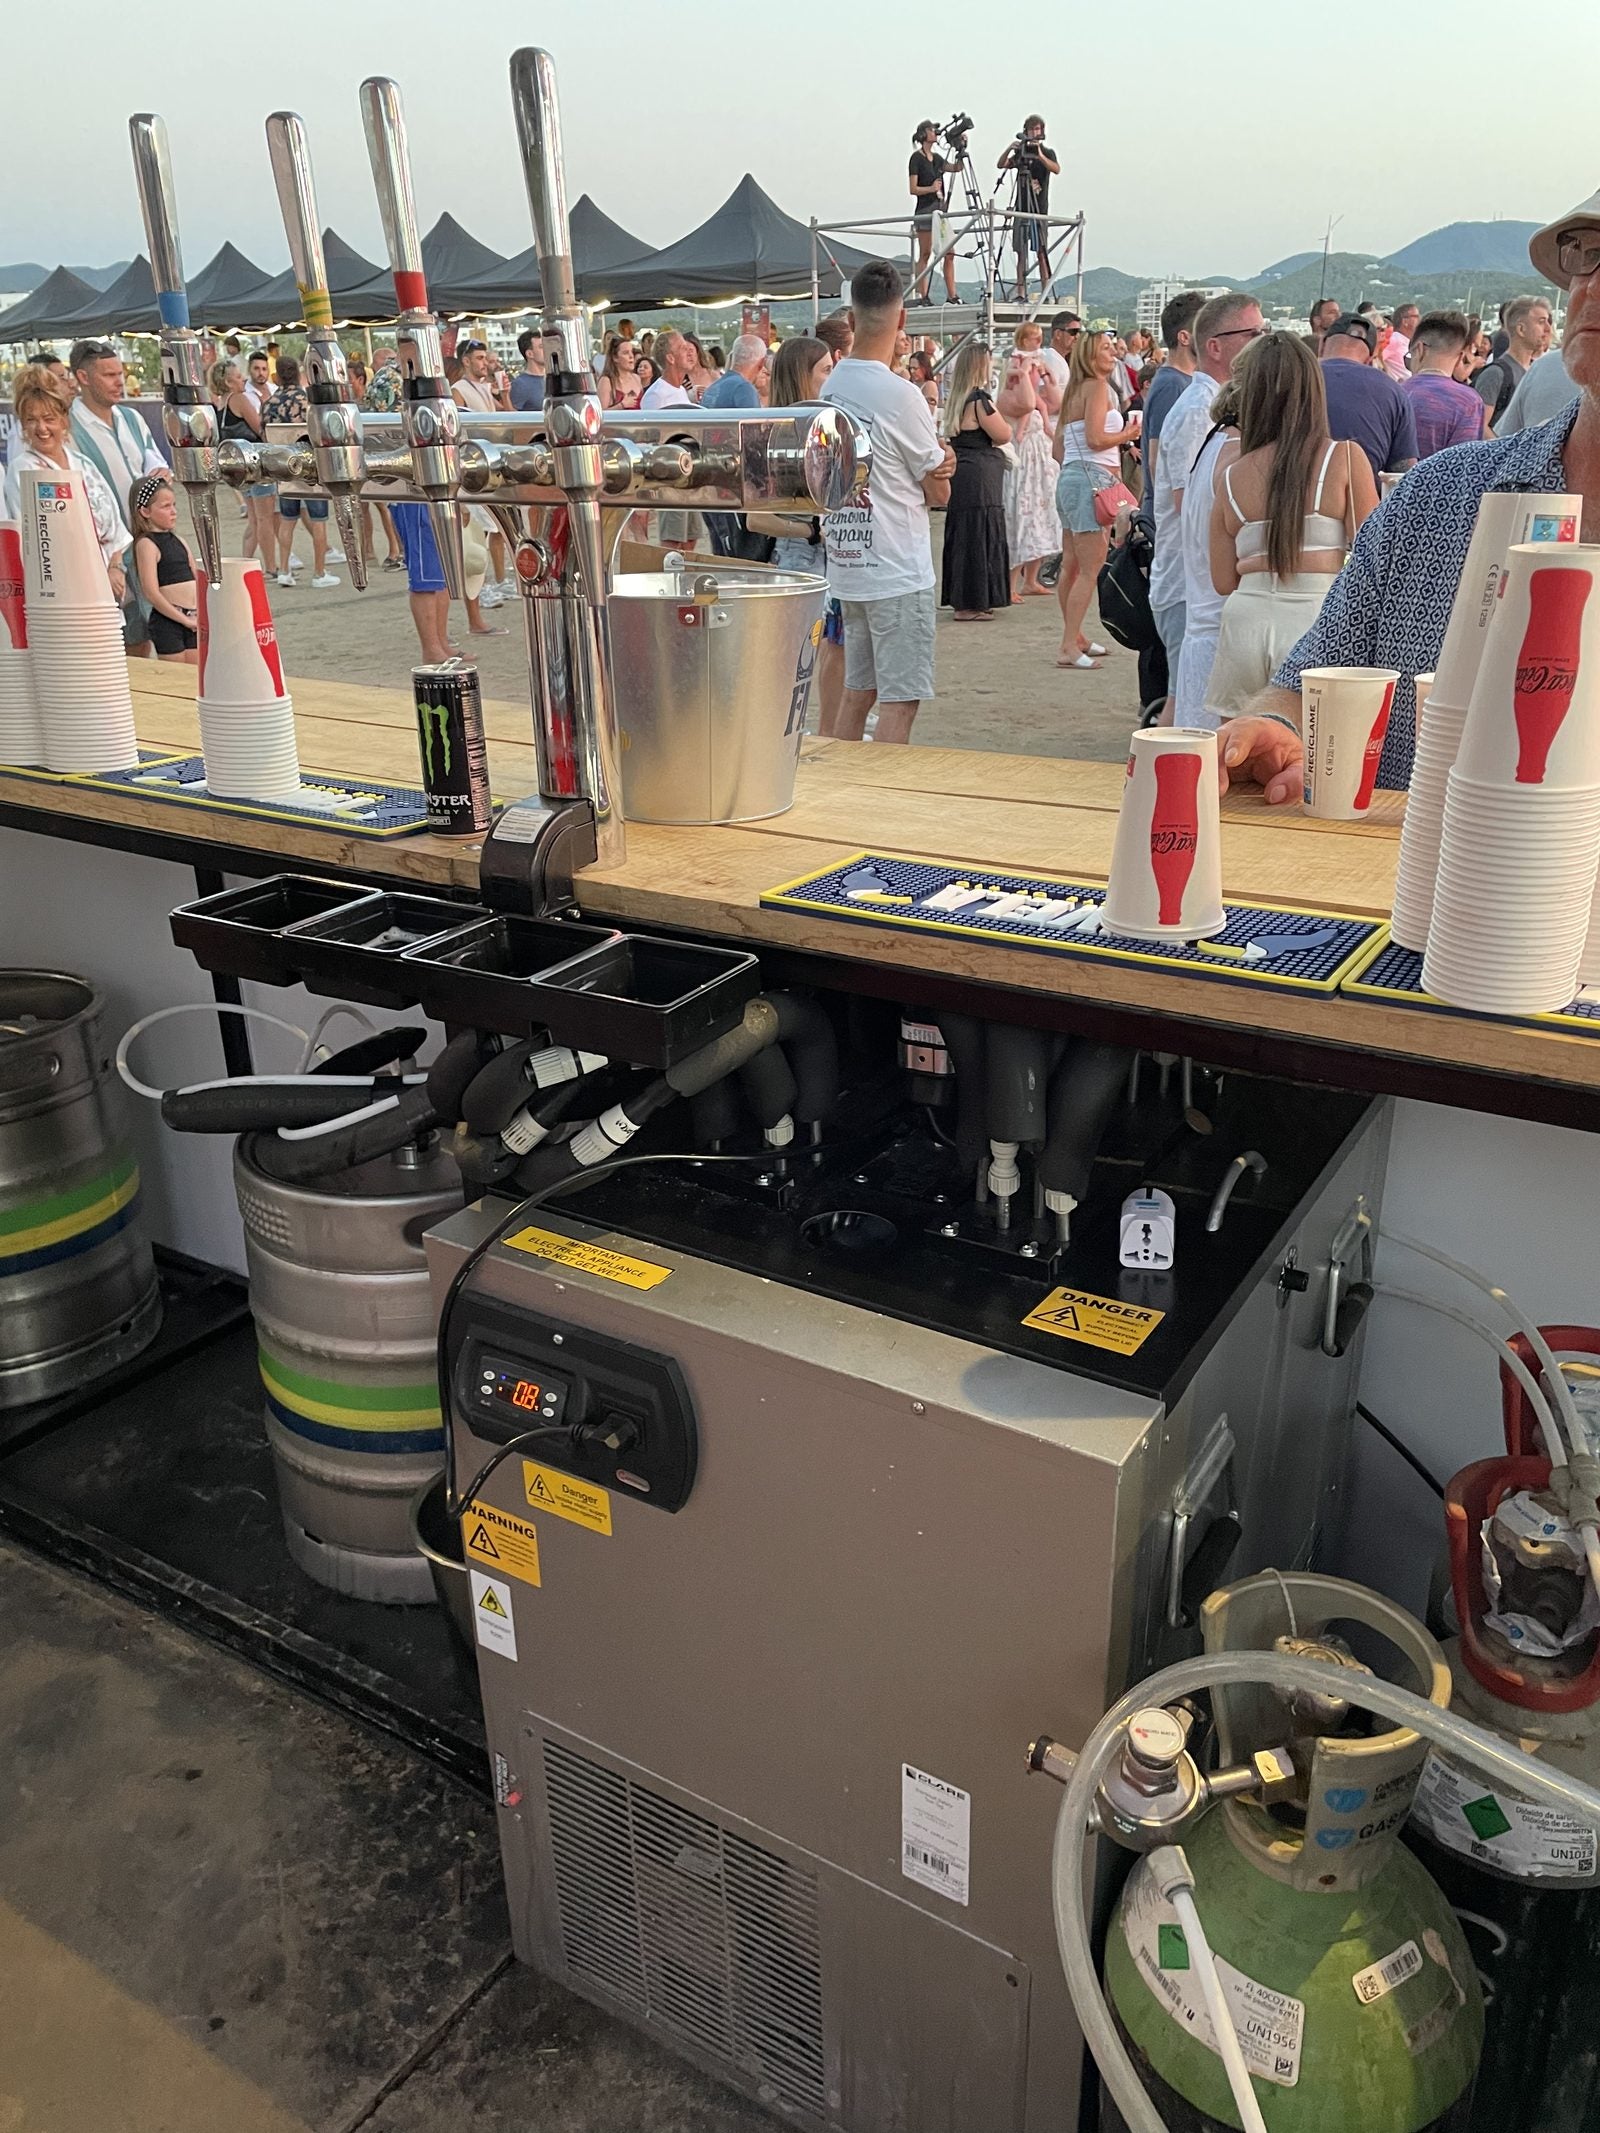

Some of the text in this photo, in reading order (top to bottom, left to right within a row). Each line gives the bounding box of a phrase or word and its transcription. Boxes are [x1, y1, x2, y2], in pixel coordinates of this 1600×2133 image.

[528, 1236, 647, 1278] ELECTRICAL APPLIANCE
[535, 1247, 621, 1278] DO NOT GET WET
[565, 1239, 624, 1262] IMPORTANT
[1060, 1292, 1153, 1323] DANGER
[513, 1381, 540, 1410] 08
[561, 1484, 599, 1505] Danger
[918, 1773, 966, 1801] CLARE
[1550, 1847, 1593, 1860] UN1013
[1246, 2019, 1297, 2051] UN1956
